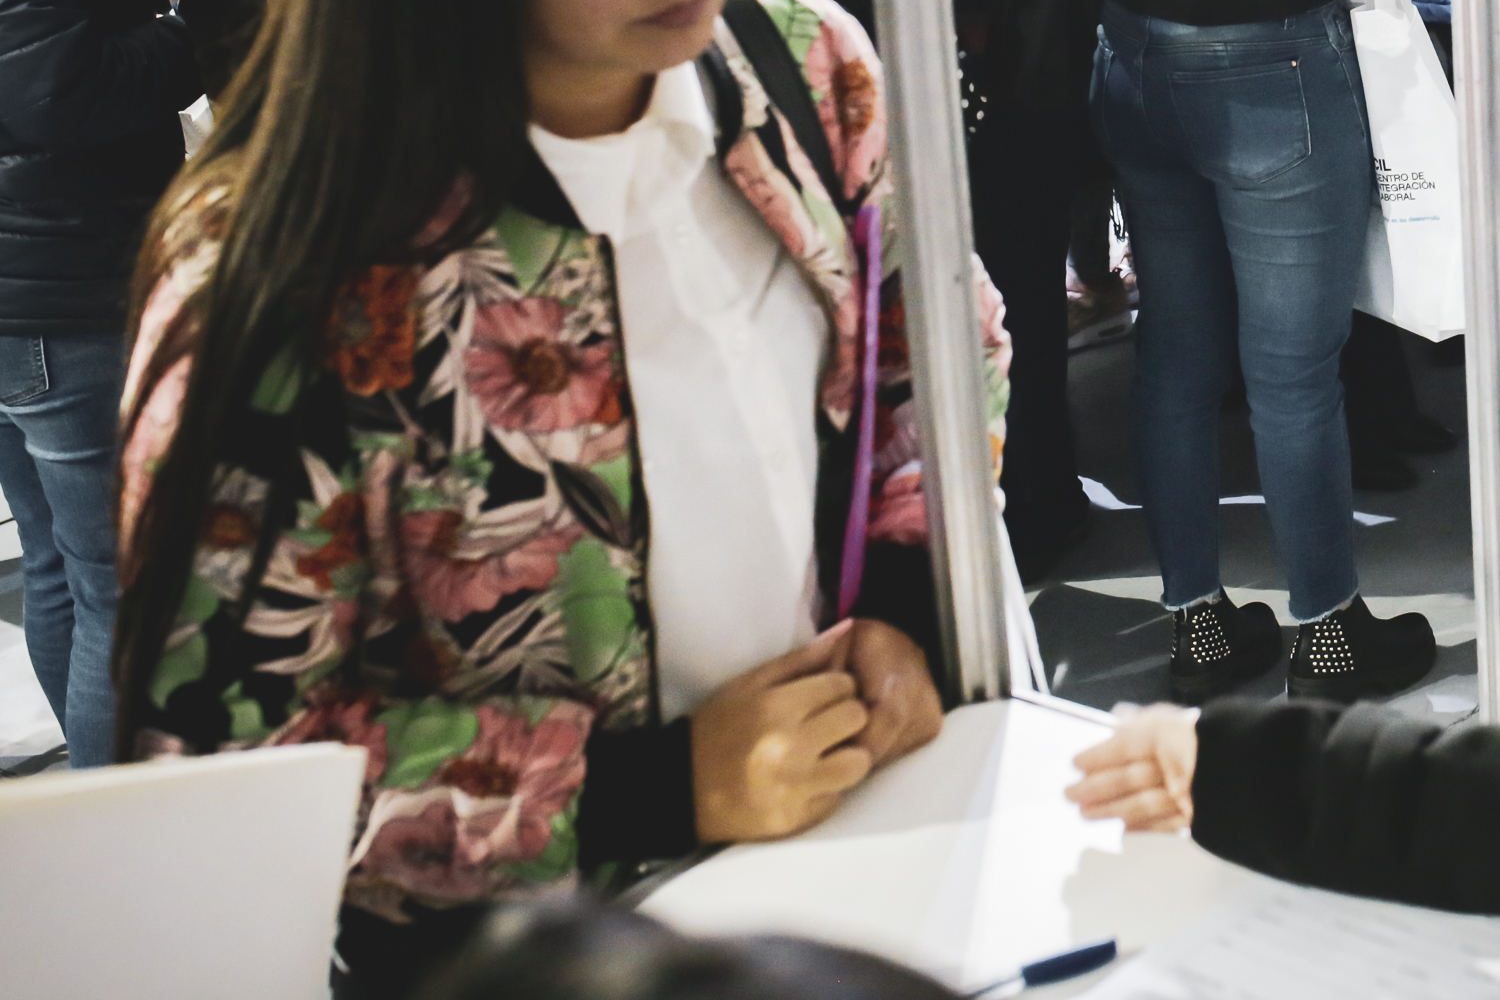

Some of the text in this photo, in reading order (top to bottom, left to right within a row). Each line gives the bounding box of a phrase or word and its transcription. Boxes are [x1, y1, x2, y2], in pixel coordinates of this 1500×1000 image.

[1377, 171, 1425, 183] ENTRO DE
[1380, 180, 1436, 192] TEGRACIÓN
[1380, 192, 1416, 202] ABORAL
